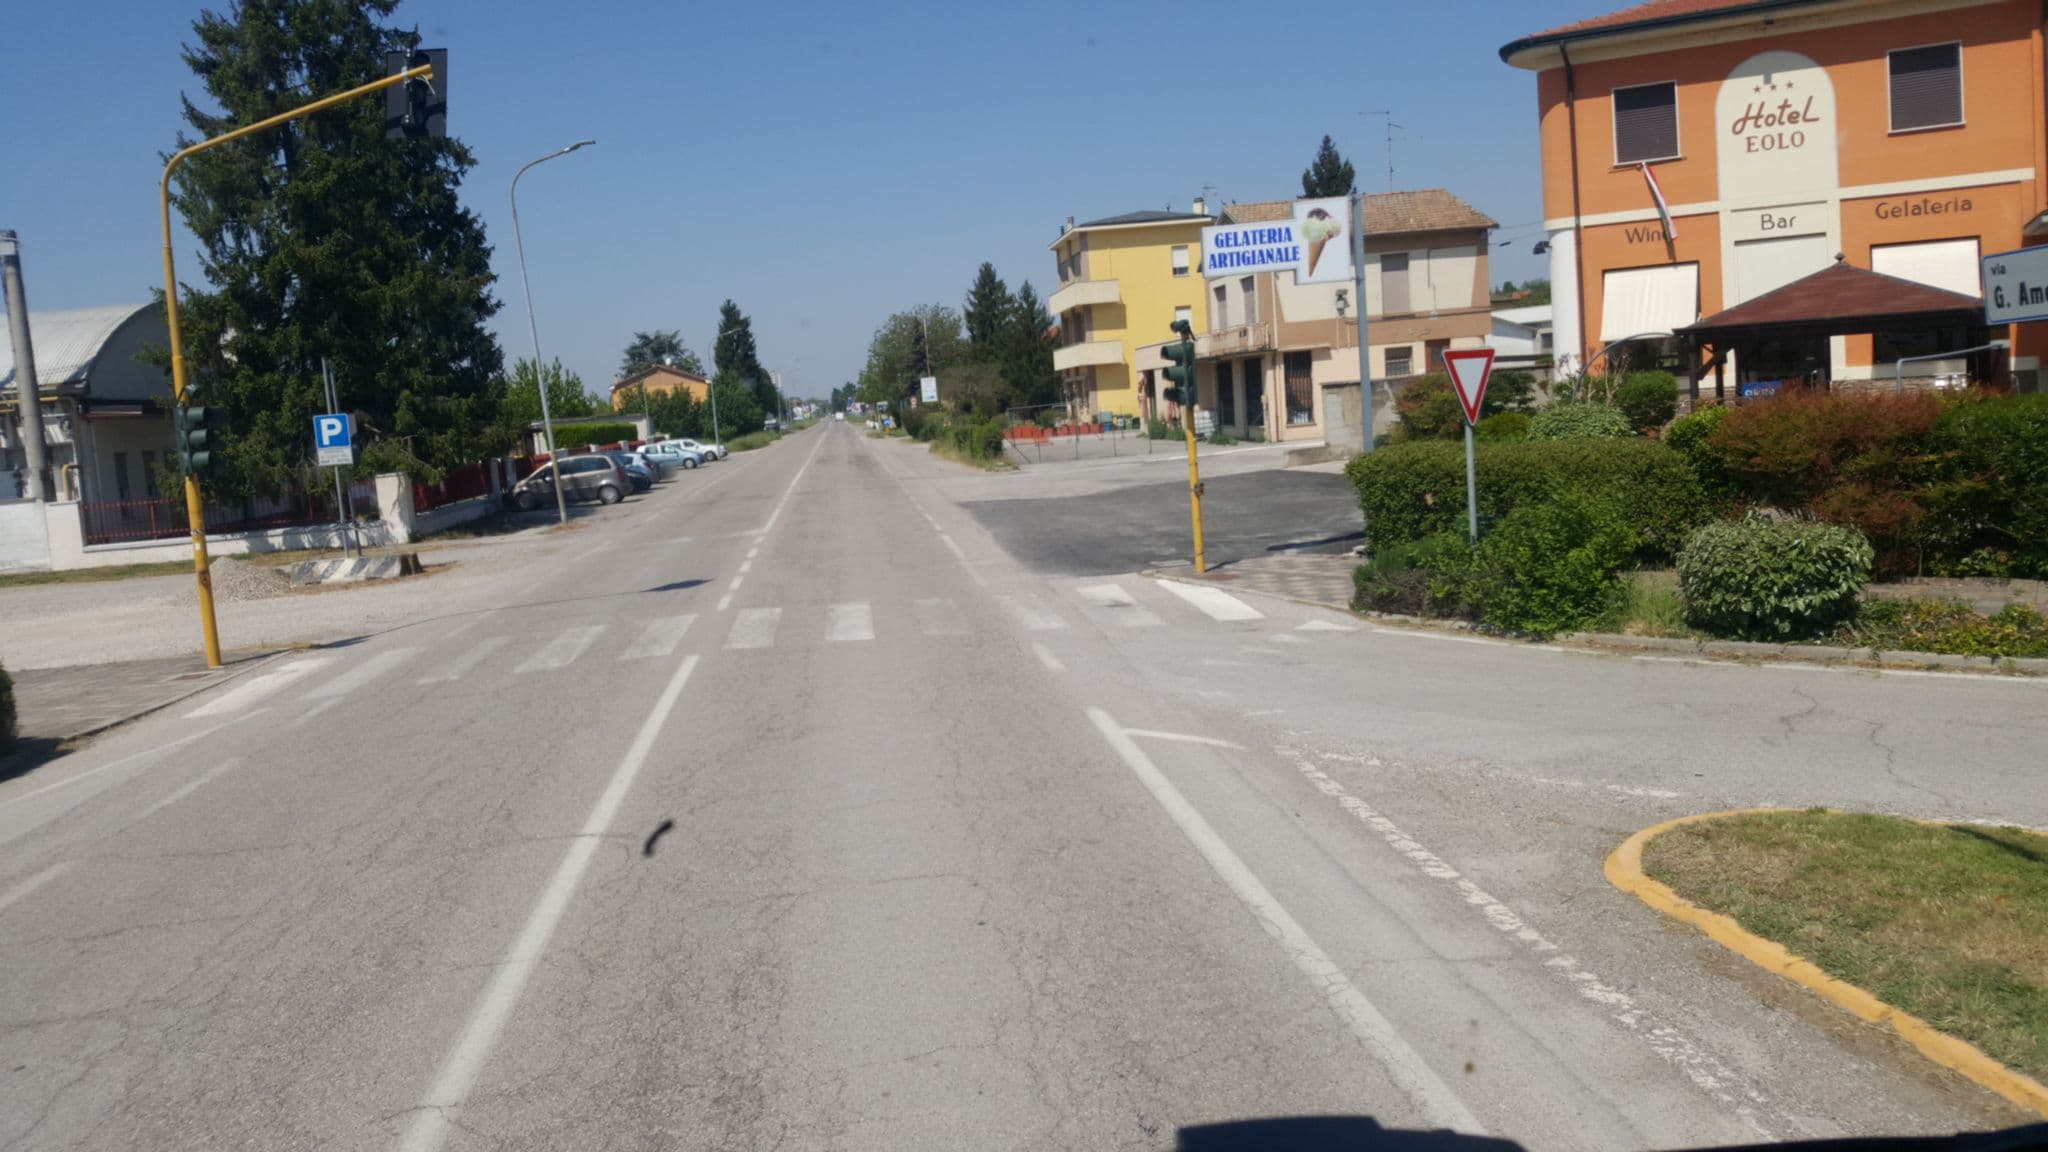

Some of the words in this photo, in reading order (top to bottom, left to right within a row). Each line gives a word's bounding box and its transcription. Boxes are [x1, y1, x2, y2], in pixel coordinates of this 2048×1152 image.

[1745, 131, 1805, 153] EOLO
[1875, 197, 1973, 219] Gelateria
[1761, 213, 1796, 231] Bar
[1214, 227, 1292, 248] GELATERIA
[1208, 246, 1300, 269] ARTIGIANALE
[1991, 264, 2007, 275] via
[1994, 286, 2011, 309] G.
[320, 418, 343, 446] P
